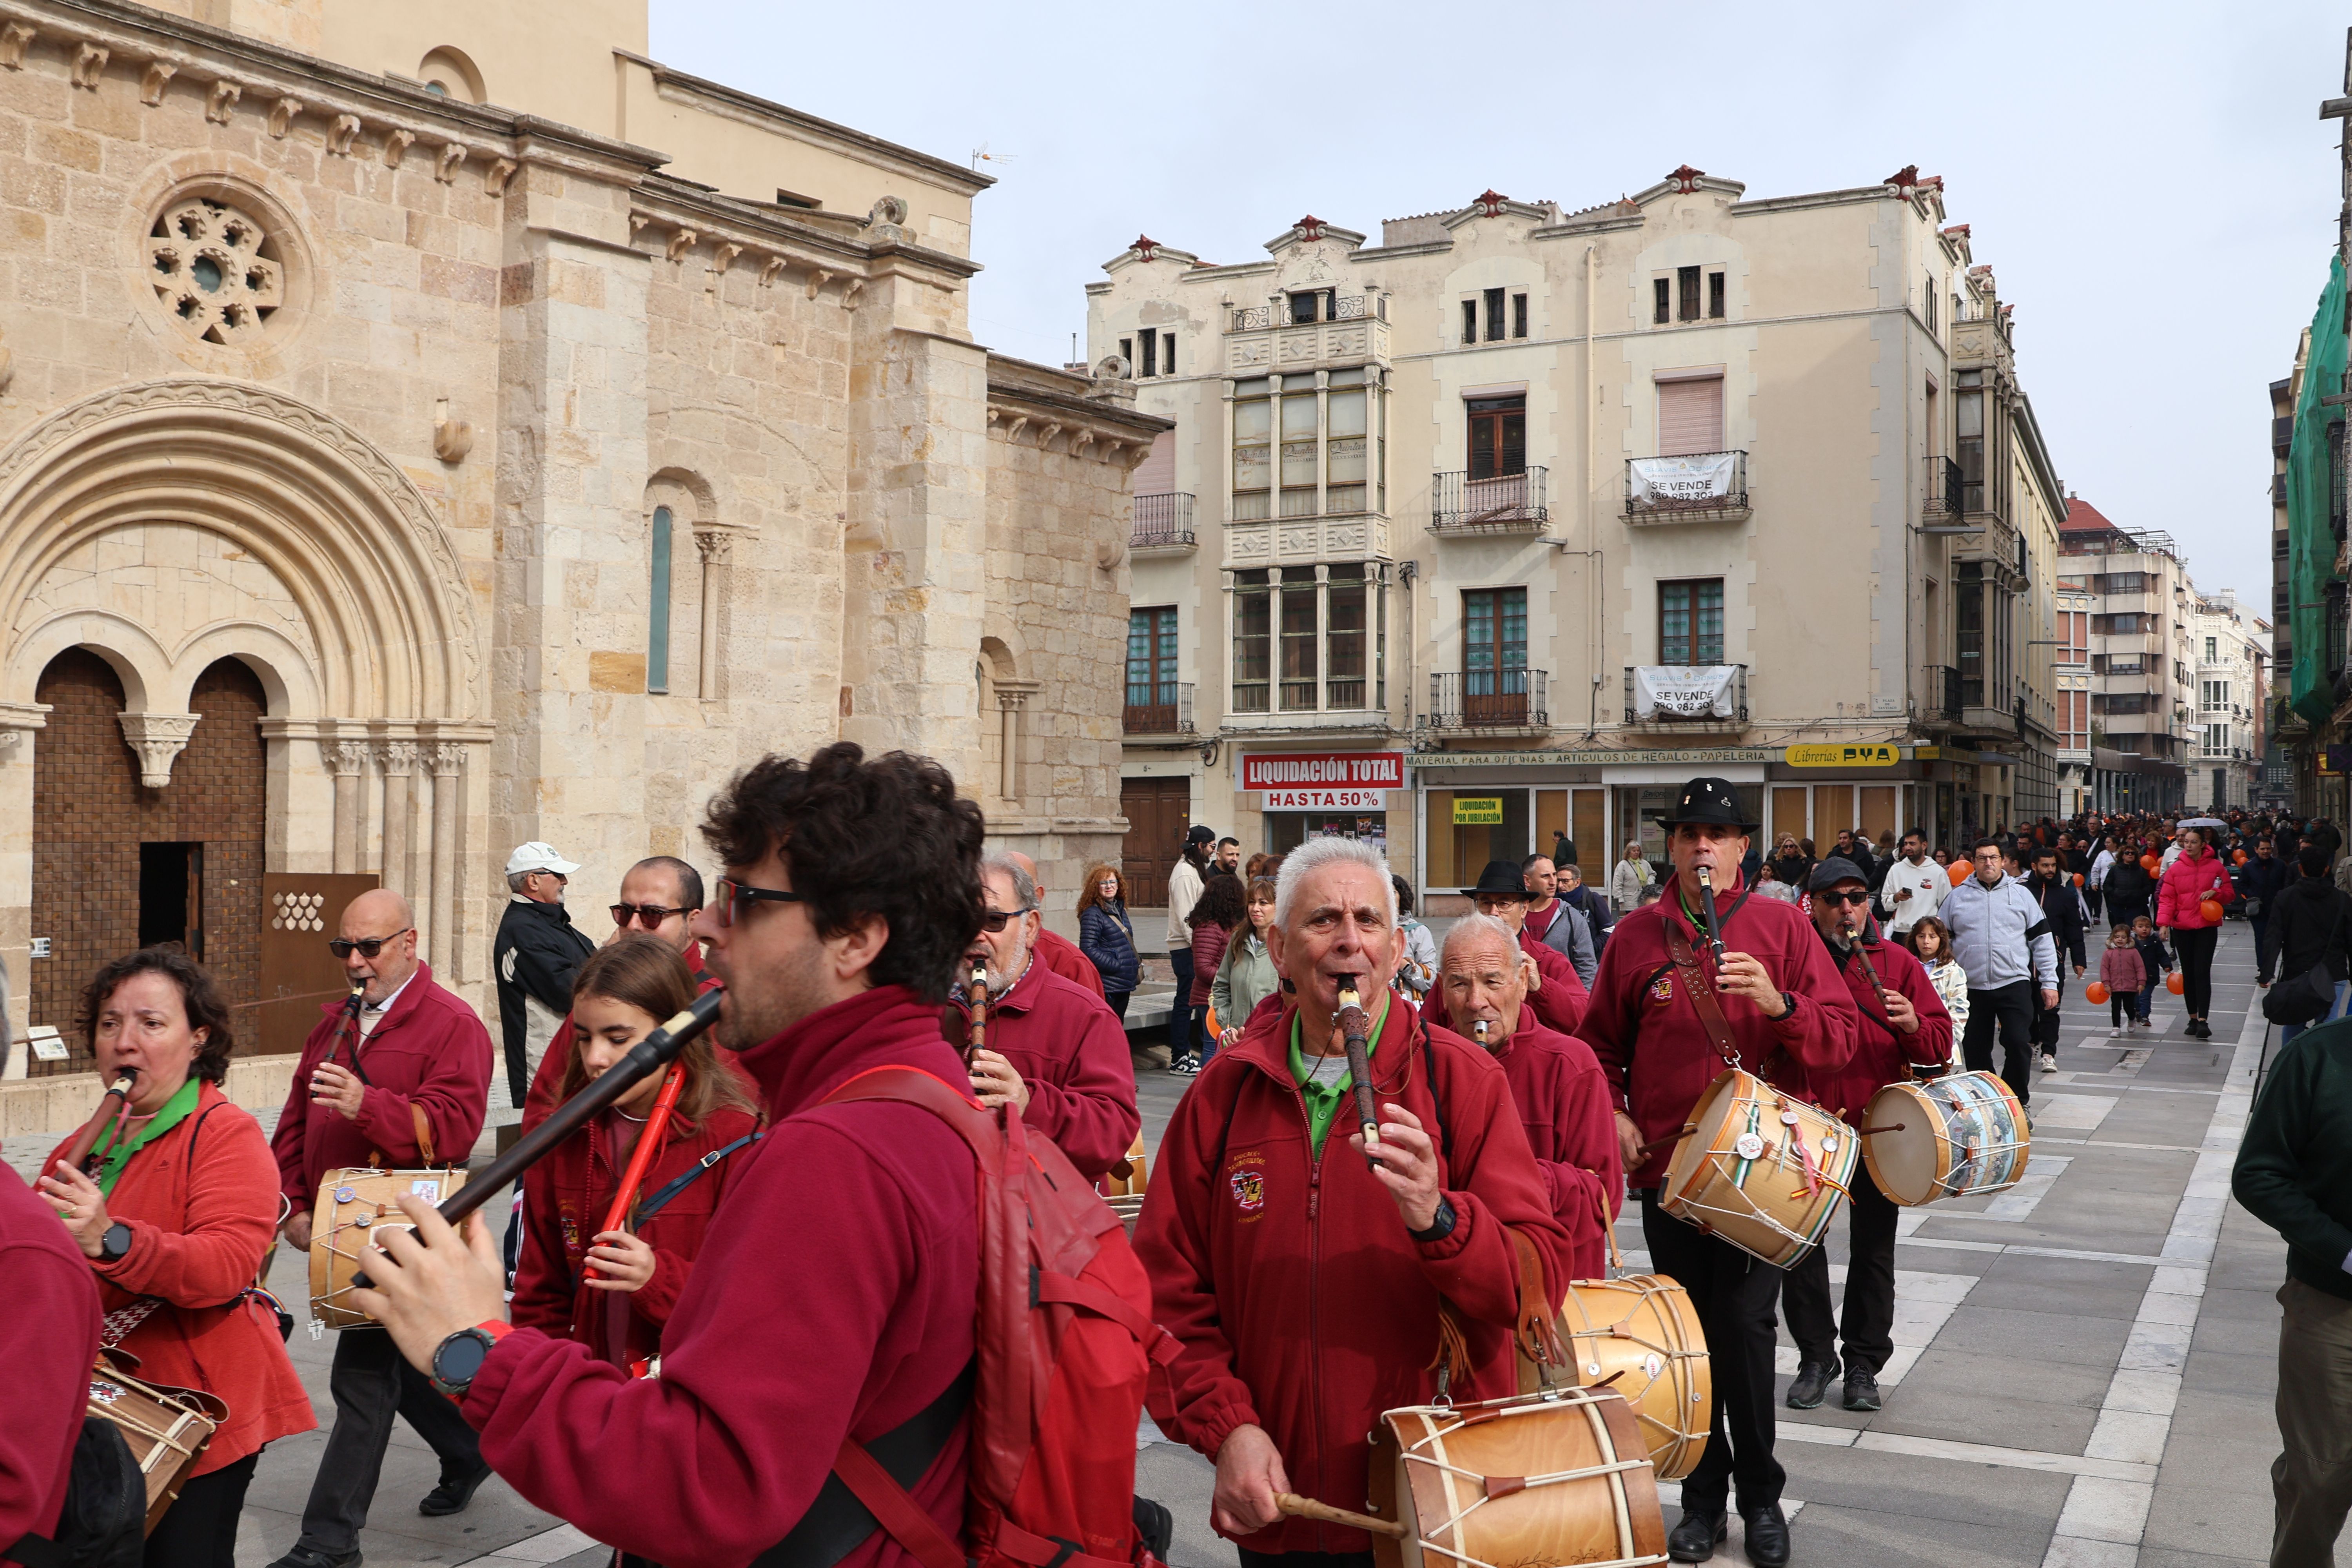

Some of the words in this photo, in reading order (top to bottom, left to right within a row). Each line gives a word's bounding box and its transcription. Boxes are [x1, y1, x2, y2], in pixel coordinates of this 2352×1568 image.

[1651, 481, 1666, 490] SE
[1670, 480, 1712, 490] VENDE
[1693, 491, 1713, 500] 303
[1656, 691, 1671, 701] SE
[1675, 690, 1713, 701] VENDE
[1677, 703, 1694, 711] 982
[1406, 756, 1459, 764] MATERIAL
[1462, 756, 1489, 764] PARA
[1494, 755, 1545, 764] OFICINAS
[1556, 753, 1619, 763] ARTICULOS
[1623, 752, 1638, 762] DE
[1642, 752, 1690, 762] REGALO
[1700, 751, 1765, 761] PAPELERIA
[1793, 748, 1837, 762] Librerías
[1843, 748, 1891, 762] PYA
[1249, 757, 1348, 784] LIQUIDACIÓN
[1351, 759, 1399, 782] TOTAL
[1269, 792, 1336, 806] HASTA
[1339, 791, 1378, 806] 50%
[1459, 799, 1496, 811] LIQUIDACIÓN
[1455, 813, 1466, 822] POR
[1467, 811, 1501, 822] JUBILACIÓN
